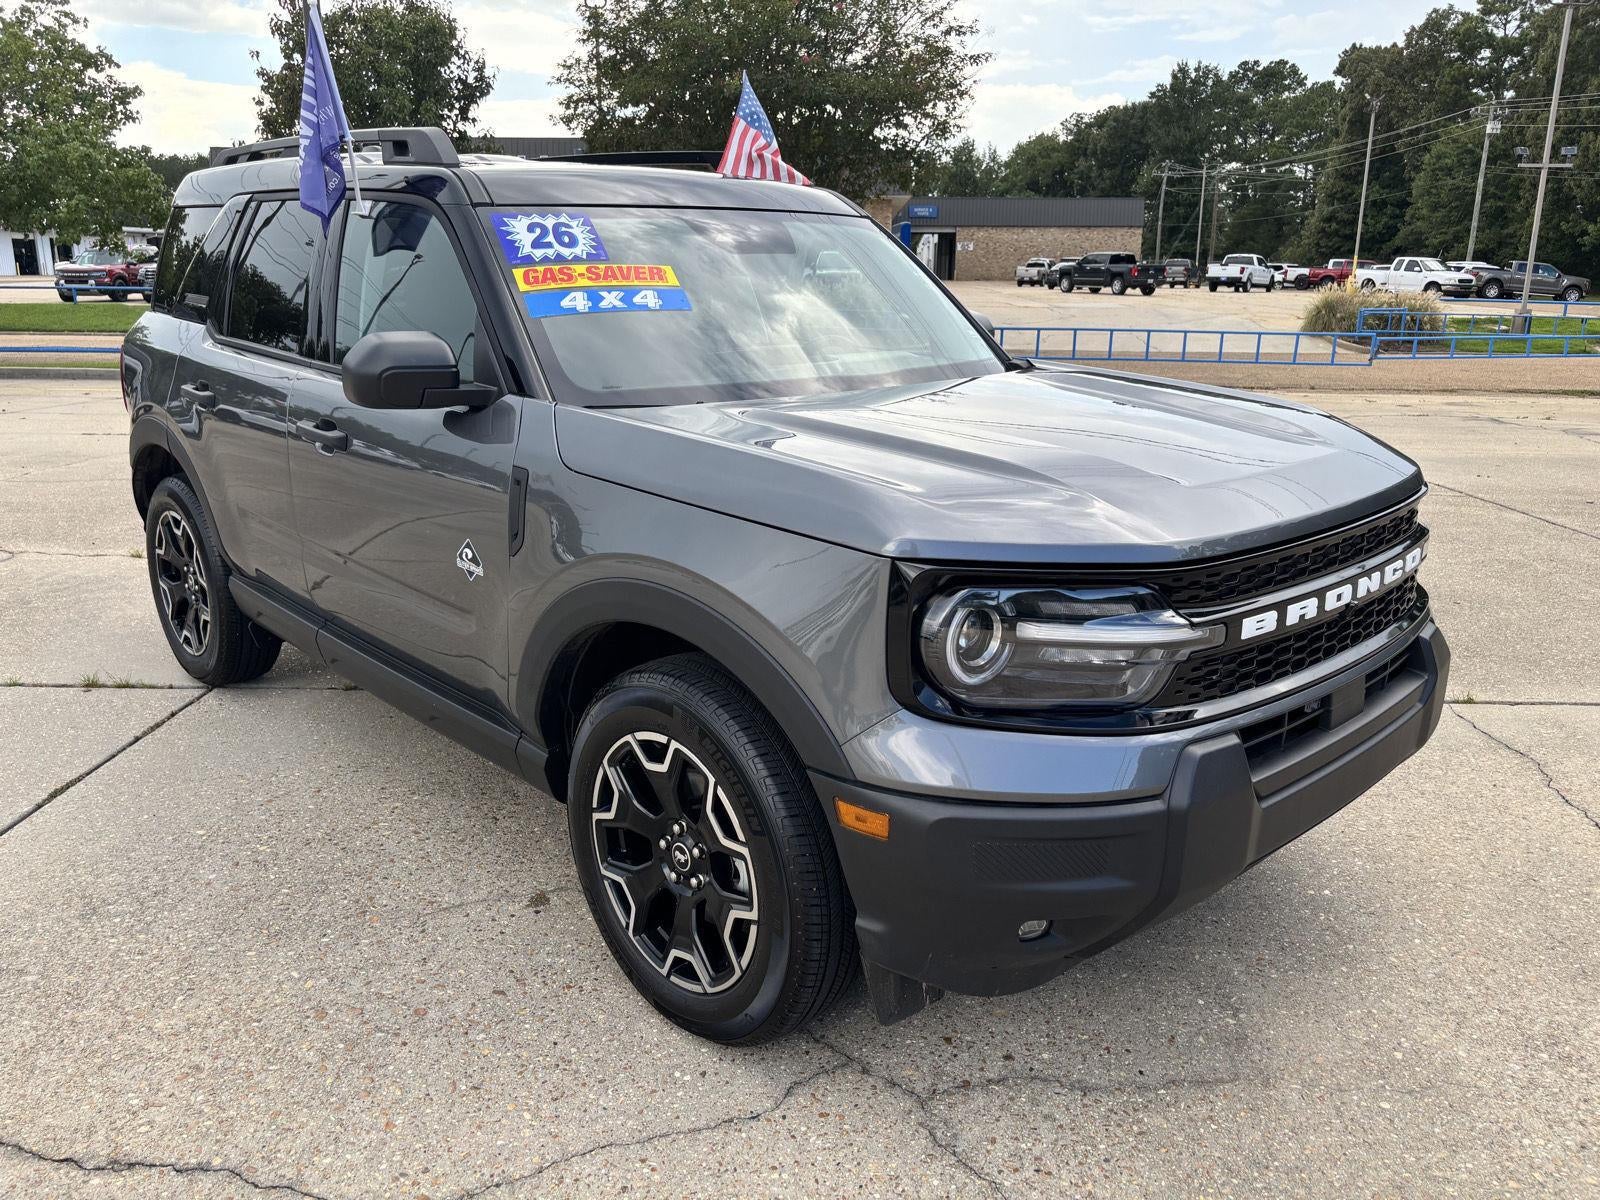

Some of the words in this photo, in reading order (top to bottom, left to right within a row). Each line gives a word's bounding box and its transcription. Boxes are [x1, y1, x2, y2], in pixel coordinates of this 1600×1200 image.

[526, 221, 579, 250] 26
[522, 265, 668, 287] GAS-SAVER
[1240, 547, 1422, 640] BRONCO
